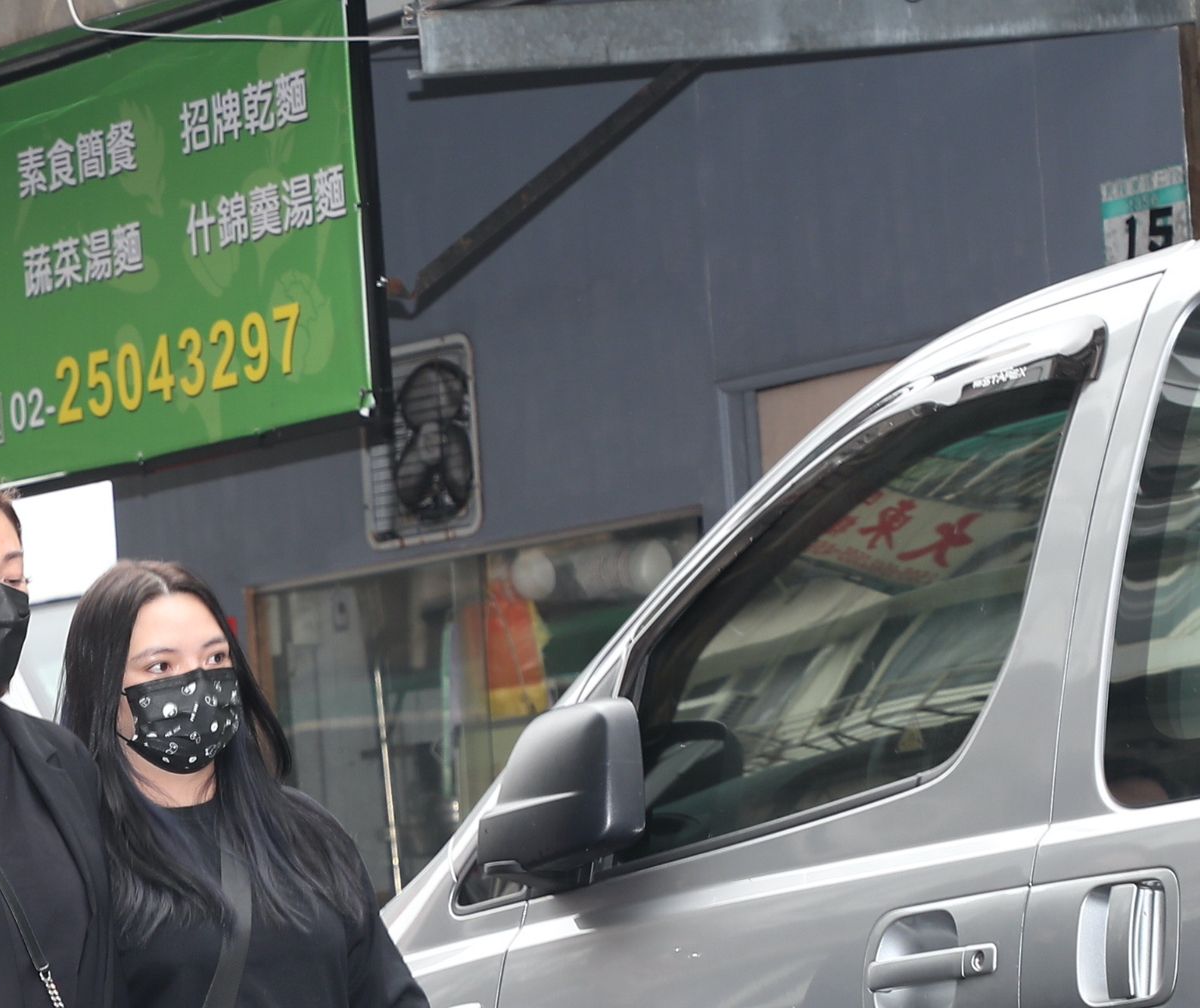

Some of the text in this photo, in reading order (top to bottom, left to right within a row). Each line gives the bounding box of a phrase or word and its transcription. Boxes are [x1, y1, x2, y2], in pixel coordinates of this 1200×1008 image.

[179, 68, 309, 155] 招牌乾麵
[16, 120, 138, 199] 素食簡餐
[186, 163, 347, 257] 什錦羹湯麵
[1125, 205, 1173, 260] 15
[22, 221, 144, 298] 蔬菜湯麵
[10, 301, 301, 433] 02-25043297
